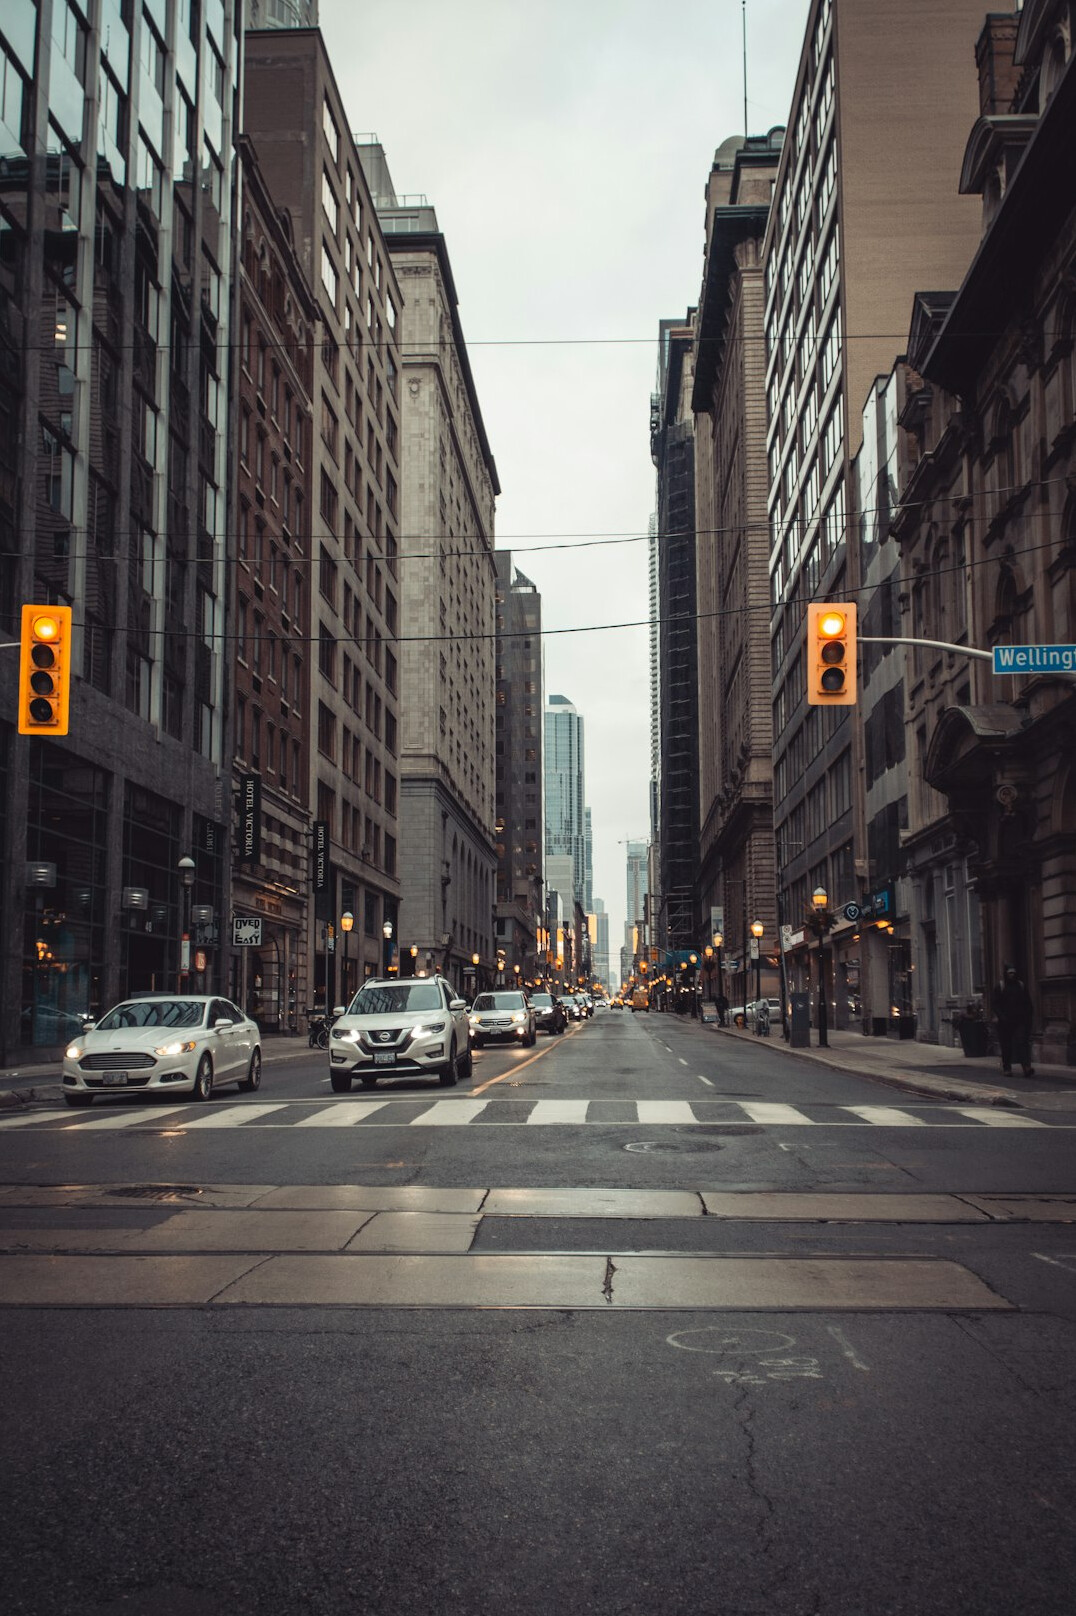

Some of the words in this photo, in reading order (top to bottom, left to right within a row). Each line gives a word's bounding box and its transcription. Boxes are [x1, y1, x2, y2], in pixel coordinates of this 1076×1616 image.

[246, 780, 254, 811] HOTEL
[245, 812, 254, 857] VICTORIA
[317, 825, 325, 851] HOTEL
[317, 851, 325, 888] VICTORIA
[235, 919, 260, 930] OVER
[235, 933, 260, 944] EASY
